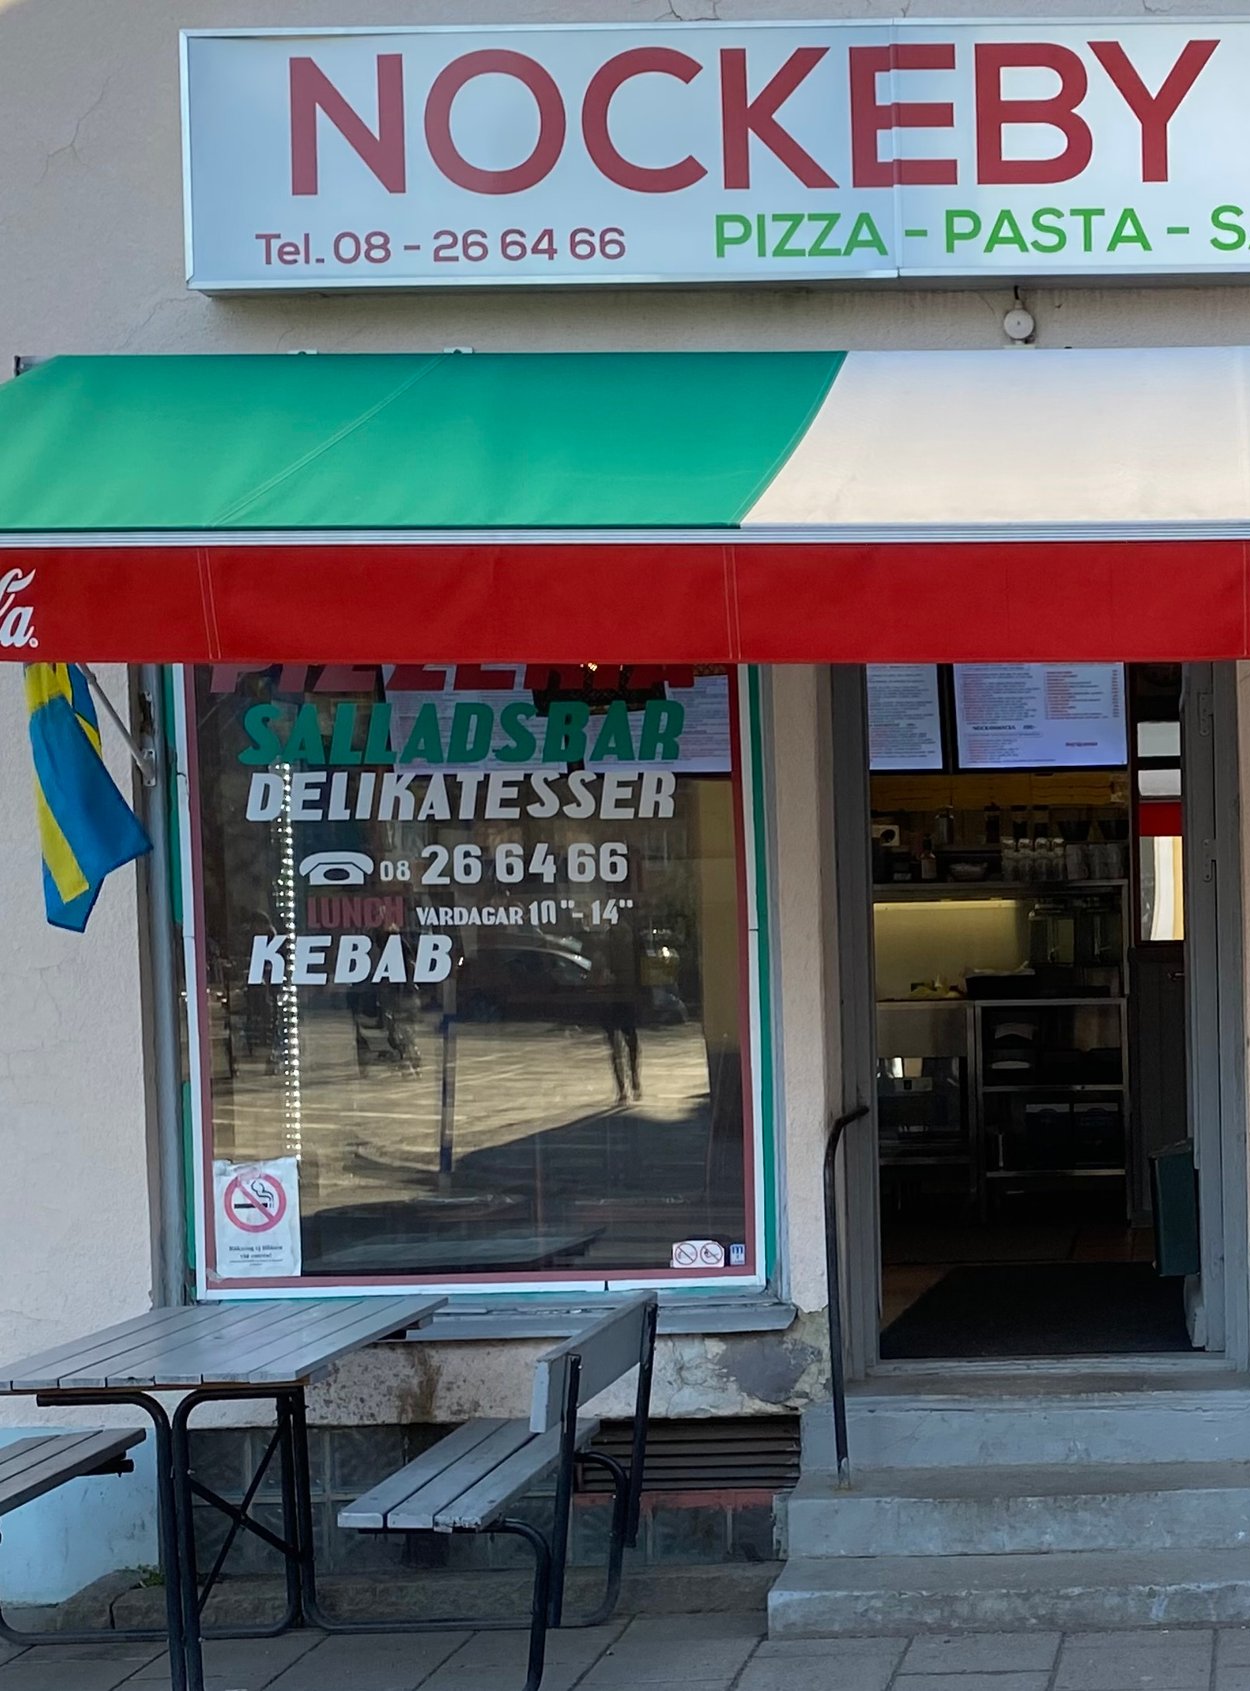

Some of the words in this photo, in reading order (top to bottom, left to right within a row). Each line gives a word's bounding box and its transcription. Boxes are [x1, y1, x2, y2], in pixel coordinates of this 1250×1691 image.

[291, 40, 1219, 195] NOCKEBY
[432, 229, 489, 262] 26
[500, 228, 558, 261] 64
[569, 227, 626, 260] 66
[714, 210, 889, 260] PIZZA
[944, 207, 1152, 255] PASTA
[237, 698, 687, 766] SALLADSBAR
[245, 770, 677, 822] DELIKATESSER
[379, 859, 411, 882] 08
[421, 844, 482, 885] 26
[495, 842, 557, 883] 64
[567, 842, 629, 882] 66
[415, 906, 524, 926] VARDAGAR
[247, 932, 454, 985] KEBAB
